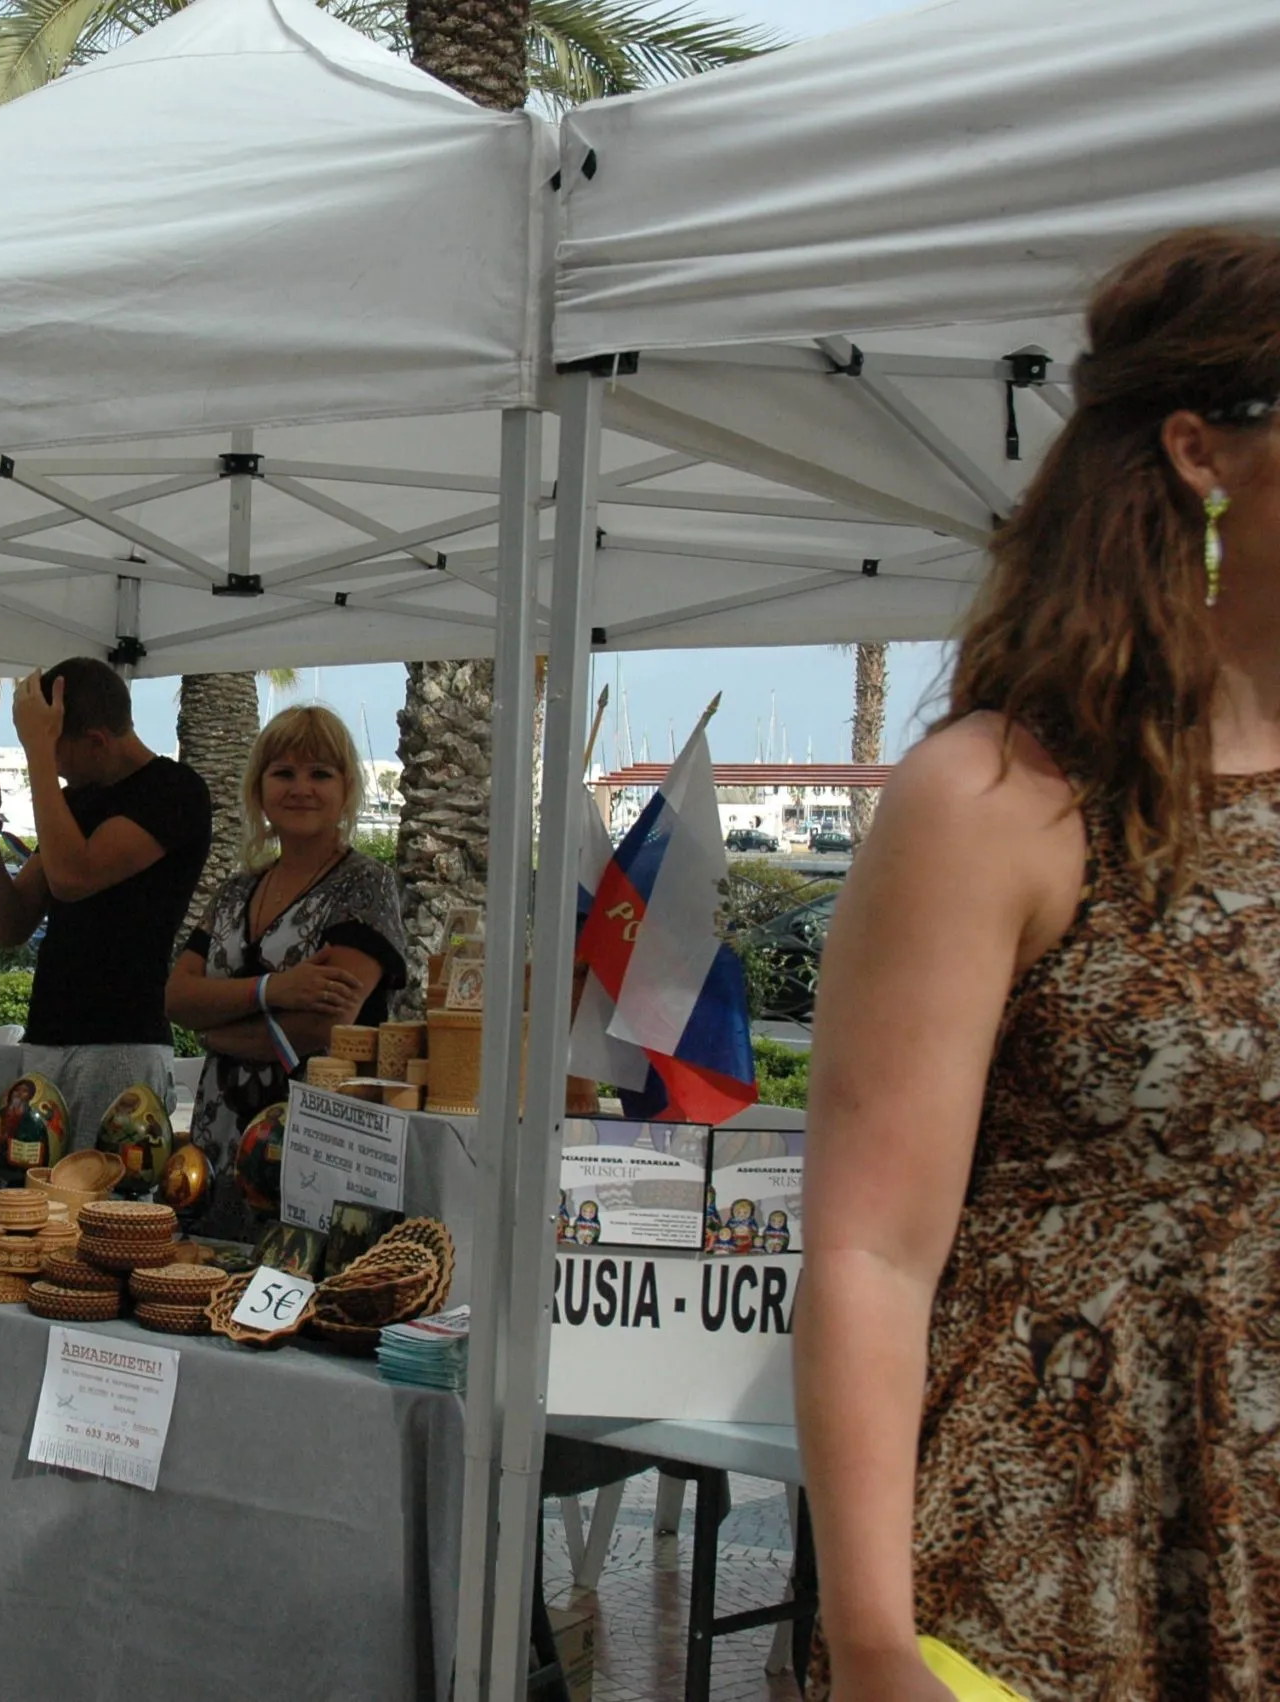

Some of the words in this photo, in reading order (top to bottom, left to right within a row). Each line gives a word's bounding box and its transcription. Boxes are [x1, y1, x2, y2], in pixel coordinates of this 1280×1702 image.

[299, 1092, 391, 1134] АВИАБИЛЕТЫ!
[250, 1283, 304, 1321] 5€
[61, 1342, 162, 1376] АВИАБИЛЕТЫ!
